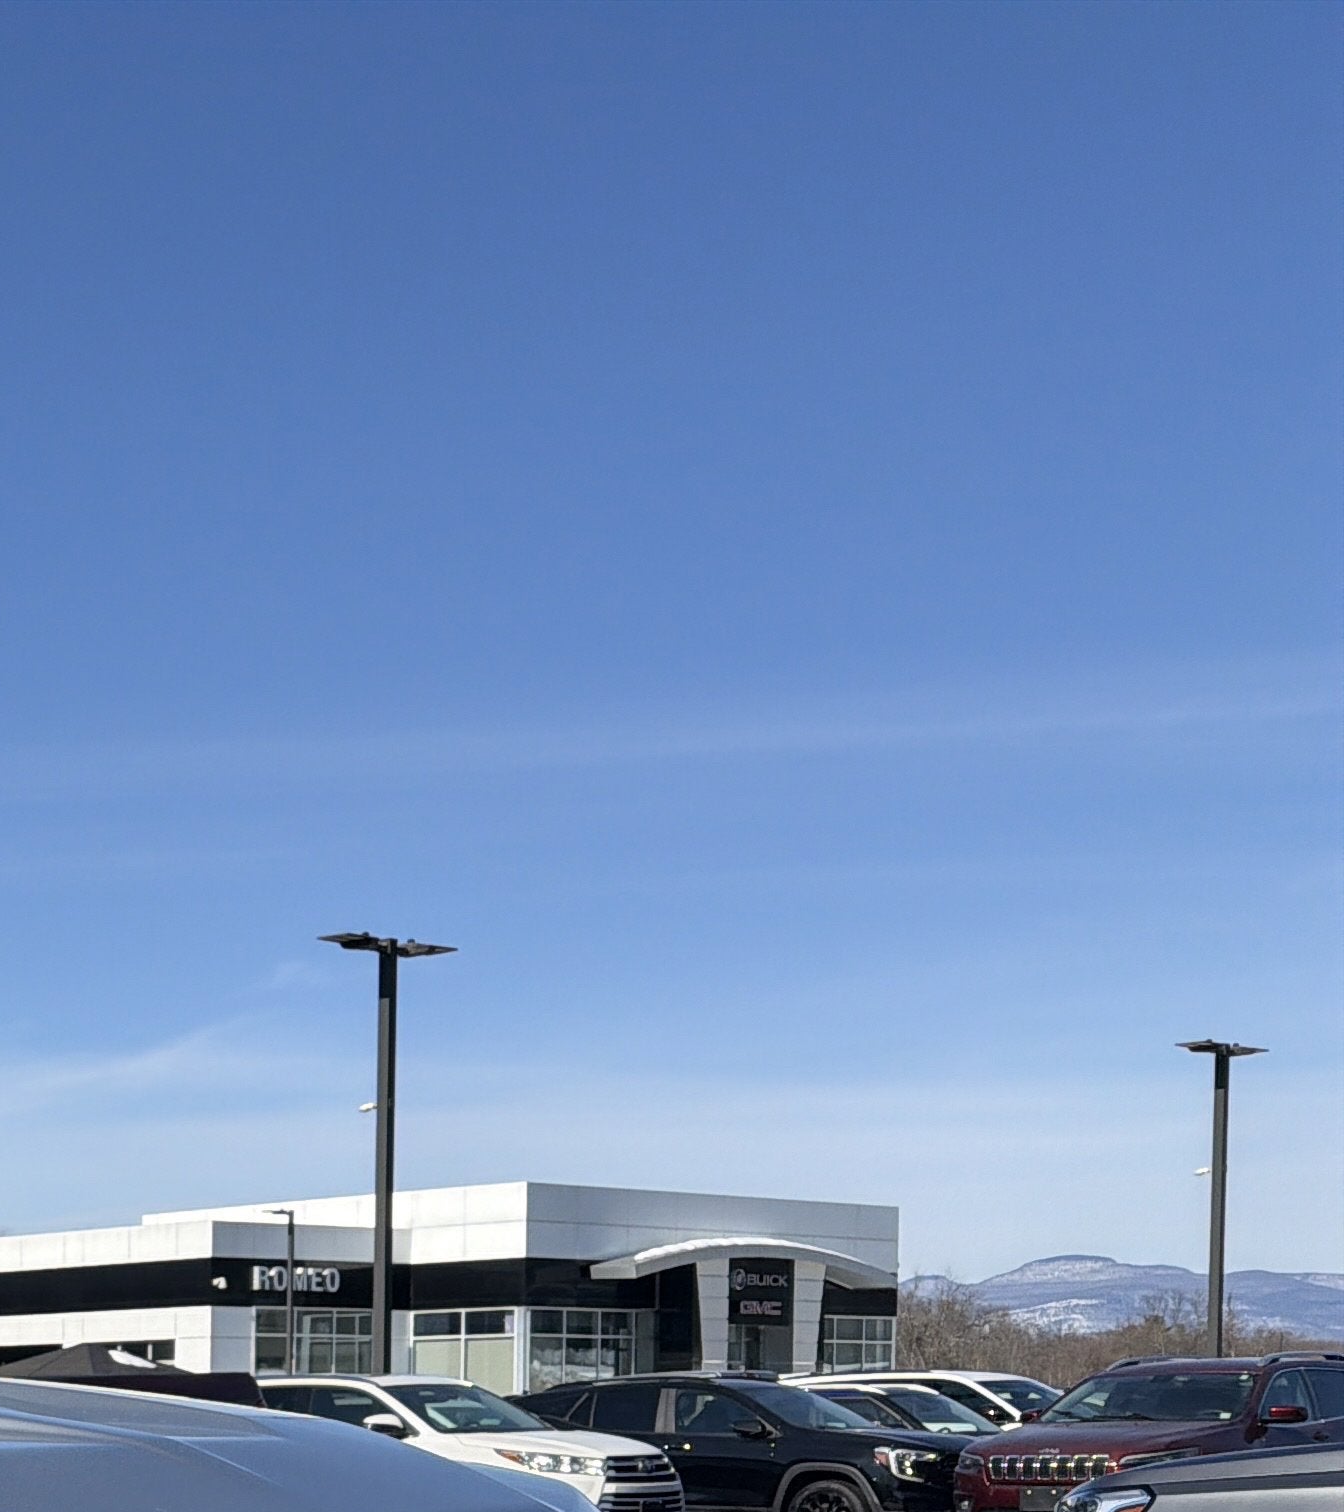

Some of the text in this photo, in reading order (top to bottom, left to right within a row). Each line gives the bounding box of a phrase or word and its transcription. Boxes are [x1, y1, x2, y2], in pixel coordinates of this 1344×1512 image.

[252, 1265, 341, 1293] ROMEO
[746, 1272, 789, 1288] BUICK
[739, 1300, 783, 1316] GMC
